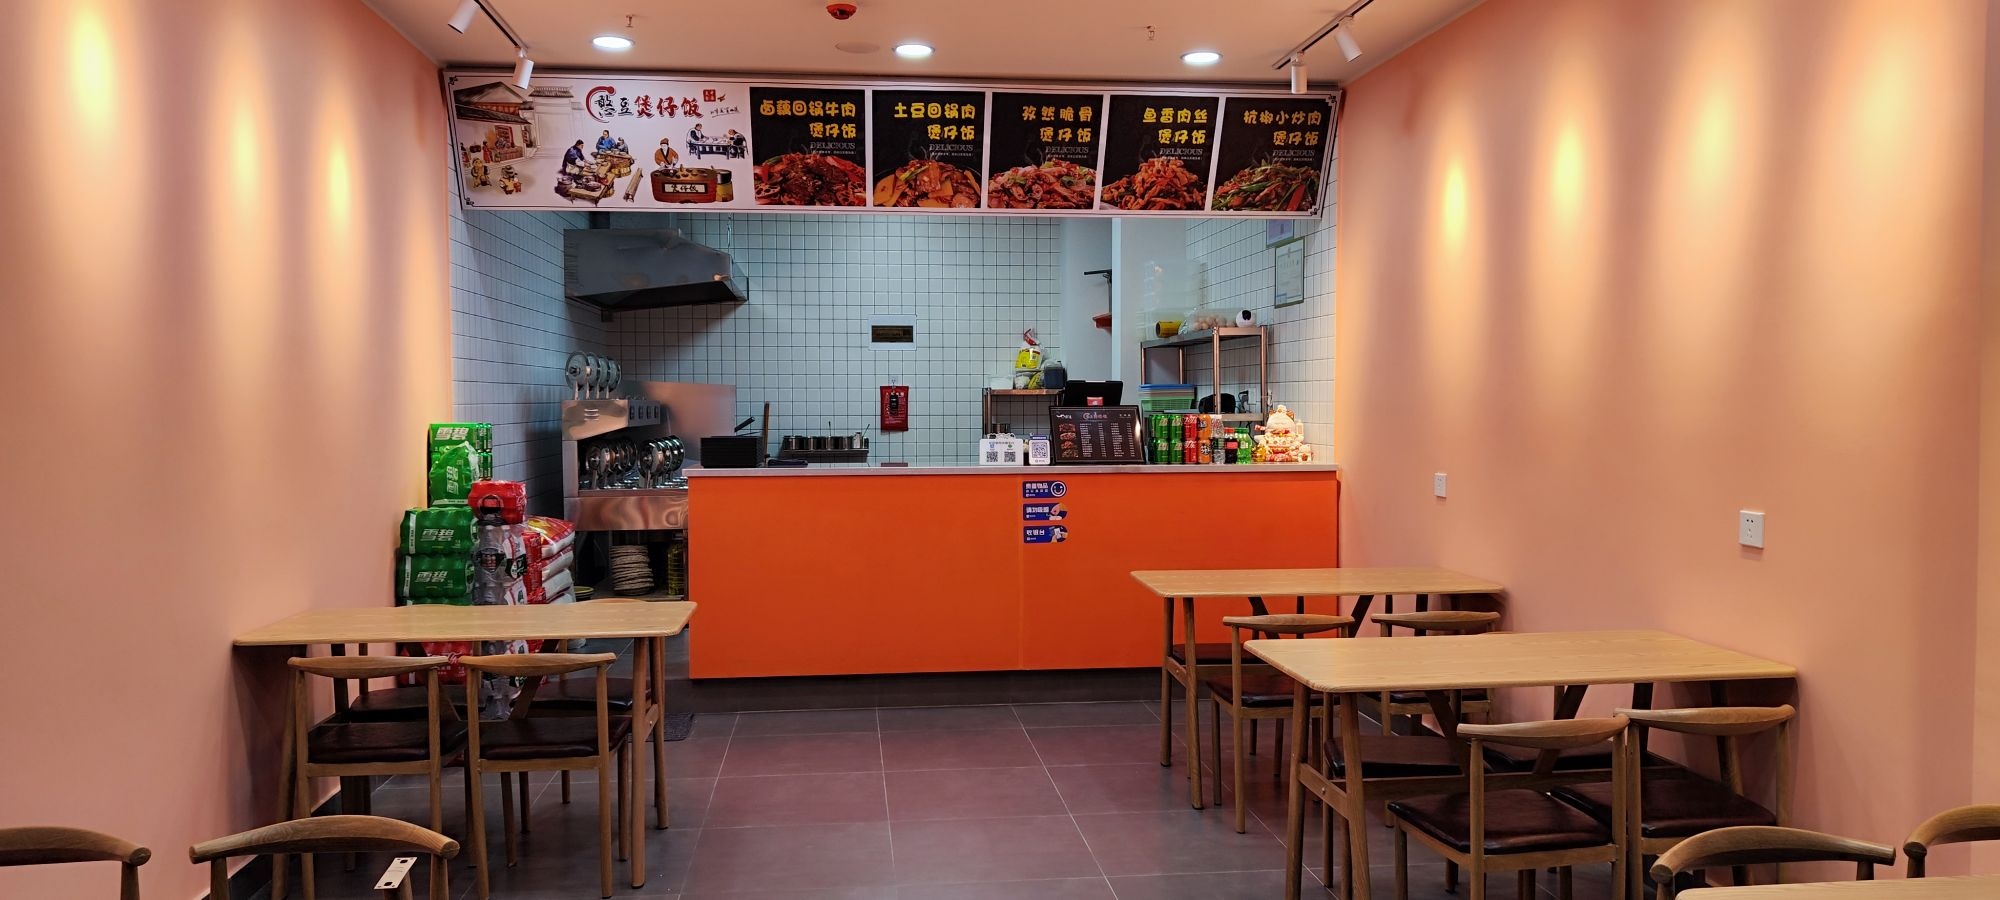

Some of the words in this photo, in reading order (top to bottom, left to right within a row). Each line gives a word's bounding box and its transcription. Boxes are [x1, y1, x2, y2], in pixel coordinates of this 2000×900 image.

[760, 99, 856, 118] 卤藕回锅牛肉
[894, 102, 976, 119] 土豆回锅肉
[1022, 105, 1093, 122] 孜然脆骨
[1142, 107, 1208, 124] 鱼香肉丝
[1243, 109, 1322, 126] 杭椒小炒肉
[809, 122, 857, 138] 煲仔饭
[927, 124, 975, 140] 煲仔饭
[1040, 126, 1092, 143] 煲仔饭
[1158, 128, 1206, 144] 煲仔饭
[1273, 130, 1319, 146] 煲仔饭
[810, 141, 856, 149] DELICIOUS
[929, 143, 974, 151] DELICIOUS
[1045, 146, 1089, 154] DELICIOUS
[1160, 147, 1204, 155] DELICIOUS
[1272, 149, 1316, 157] DELICIOUS
[434, 427, 469, 440] 雪碧
[420, 528, 454, 541] 雪碧
[415, 570, 448, 583] 雪碧
